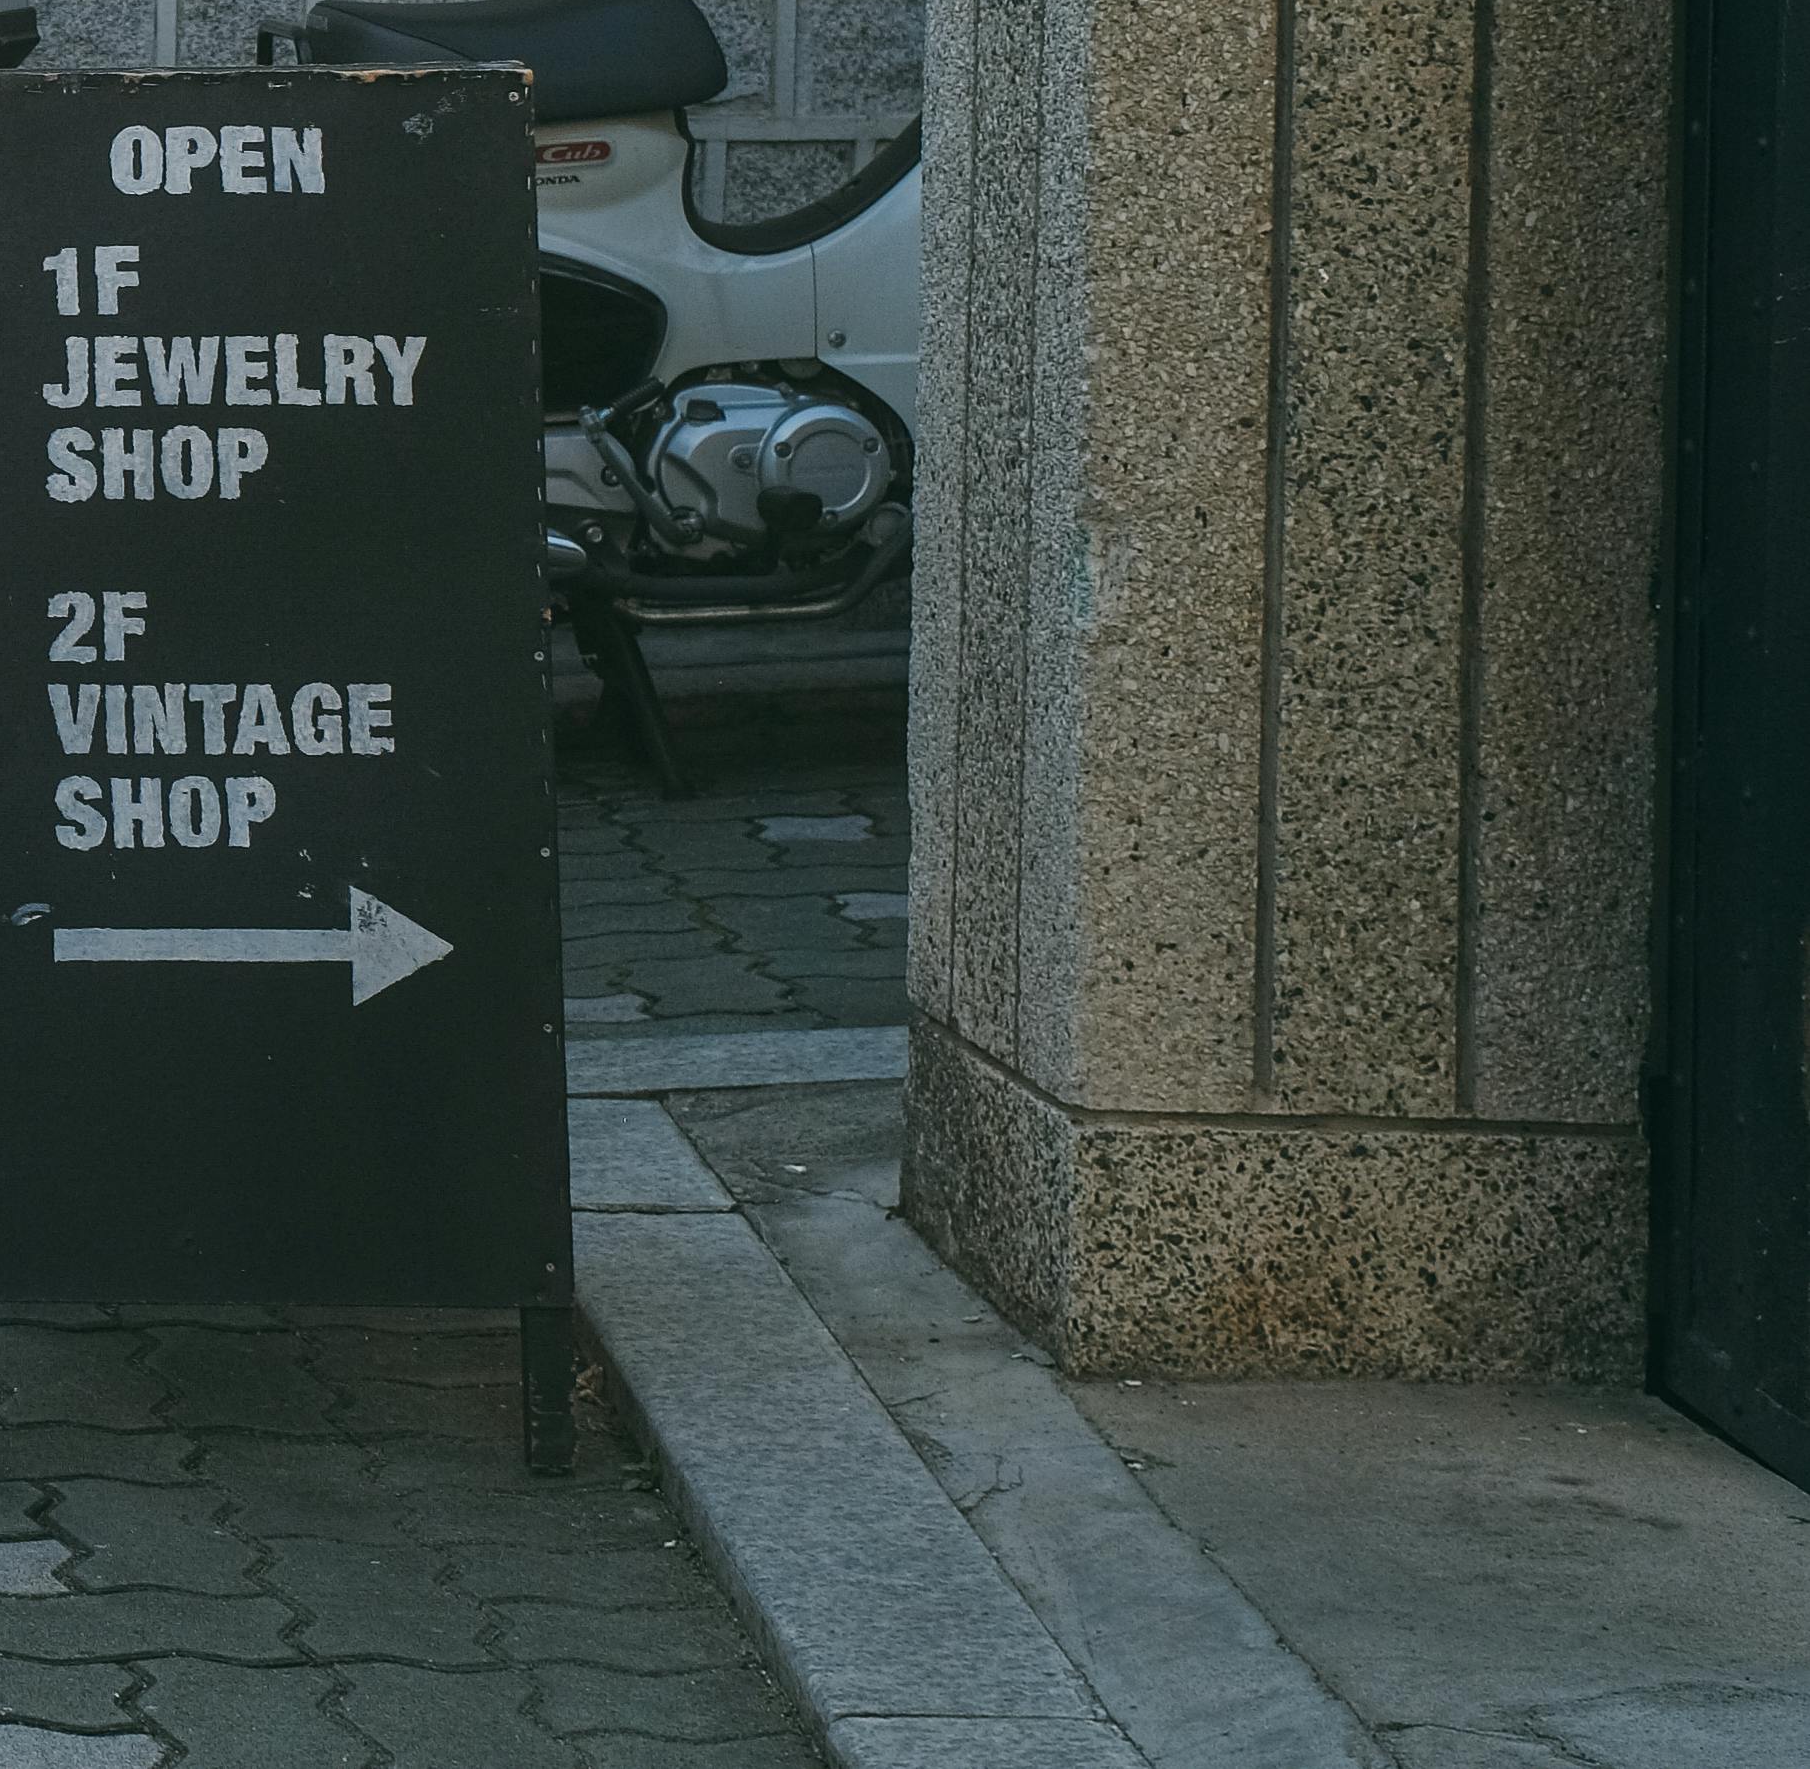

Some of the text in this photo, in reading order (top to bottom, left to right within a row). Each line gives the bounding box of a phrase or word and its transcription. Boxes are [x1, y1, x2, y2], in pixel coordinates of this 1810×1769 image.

[110, 125, 325, 195] OPEN
[535, 174, 581, 186] ONDA
[43, 245, 140, 316] 1F
[43, 333, 428, 408] JEWELRY
[46, 425, 268, 503] SHOP
[48, 591, 147, 664] 2F
[48, 682, 395, 756] VINTAGE
[55, 775, 276, 851] SHOP
